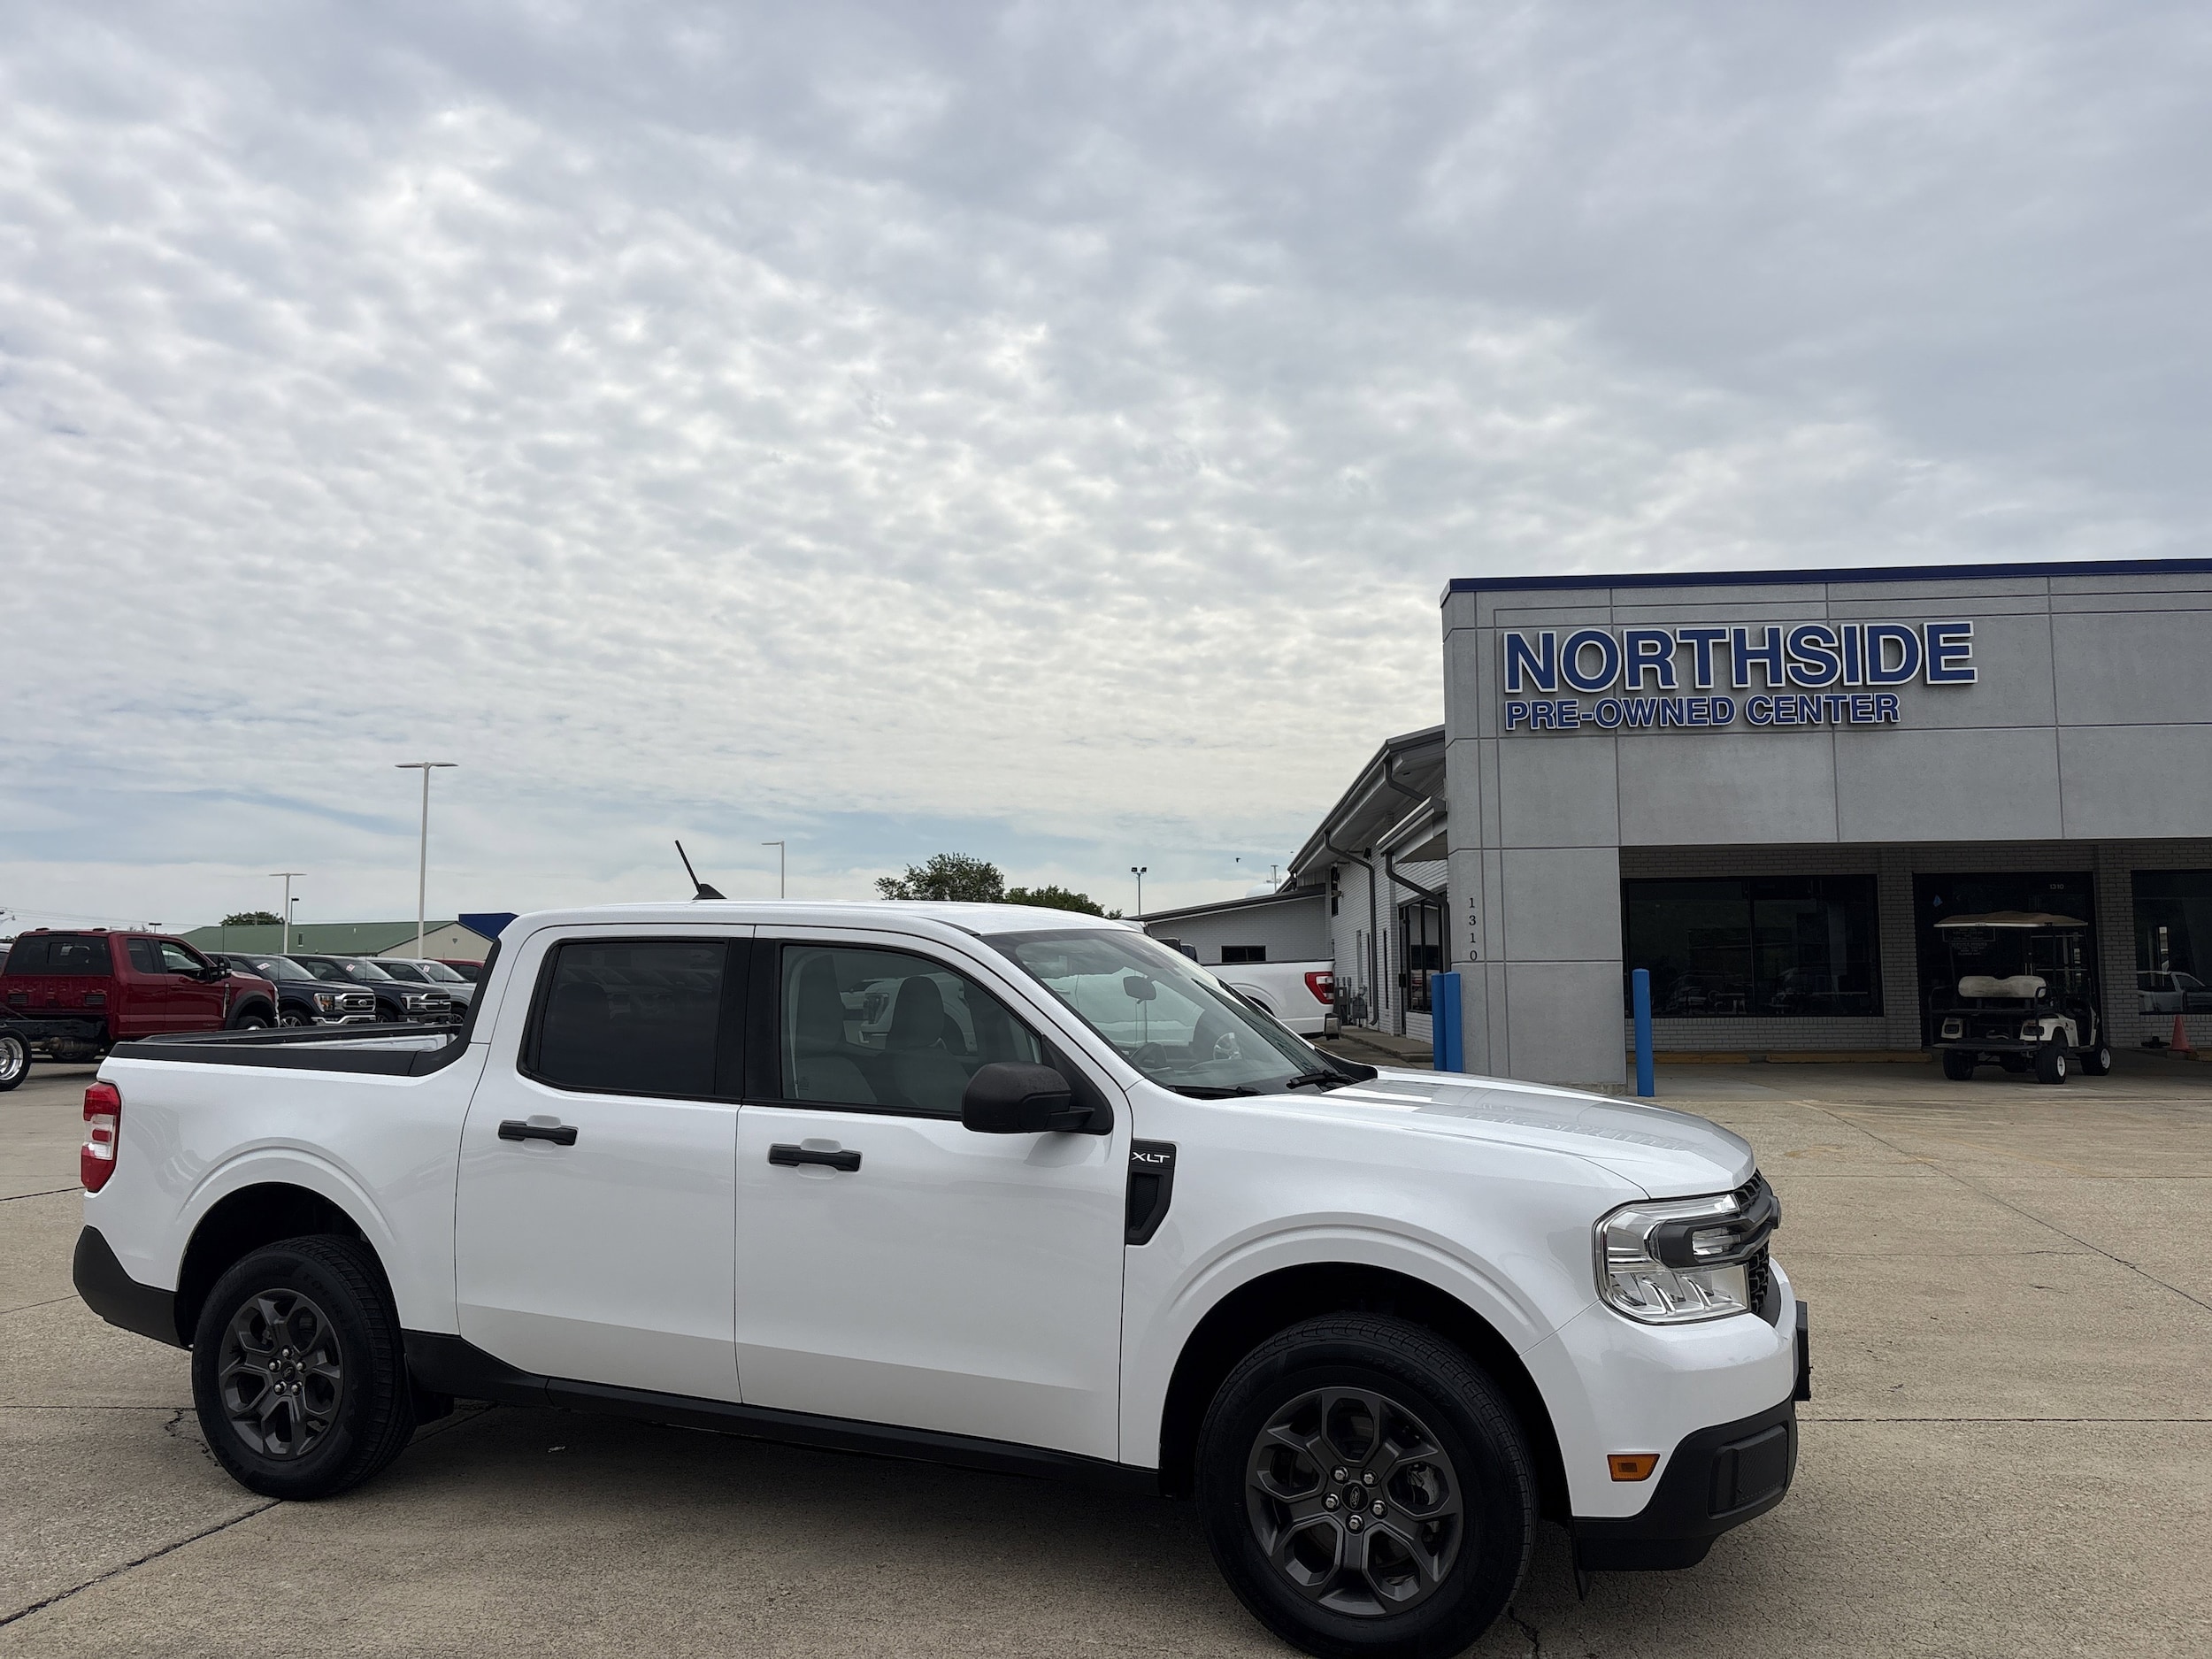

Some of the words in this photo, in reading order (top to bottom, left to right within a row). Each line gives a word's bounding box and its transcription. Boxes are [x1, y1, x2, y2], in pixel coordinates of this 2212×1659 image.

[1504, 620, 1978, 693] NORTHSIDE
[1505, 695, 1736, 730] PRE-OWNED
[1745, 693, 1901, 726] CENTER
[1469, 897, 1478, 962] 1310
[1132, 1151, 1171, 1164] XLT
